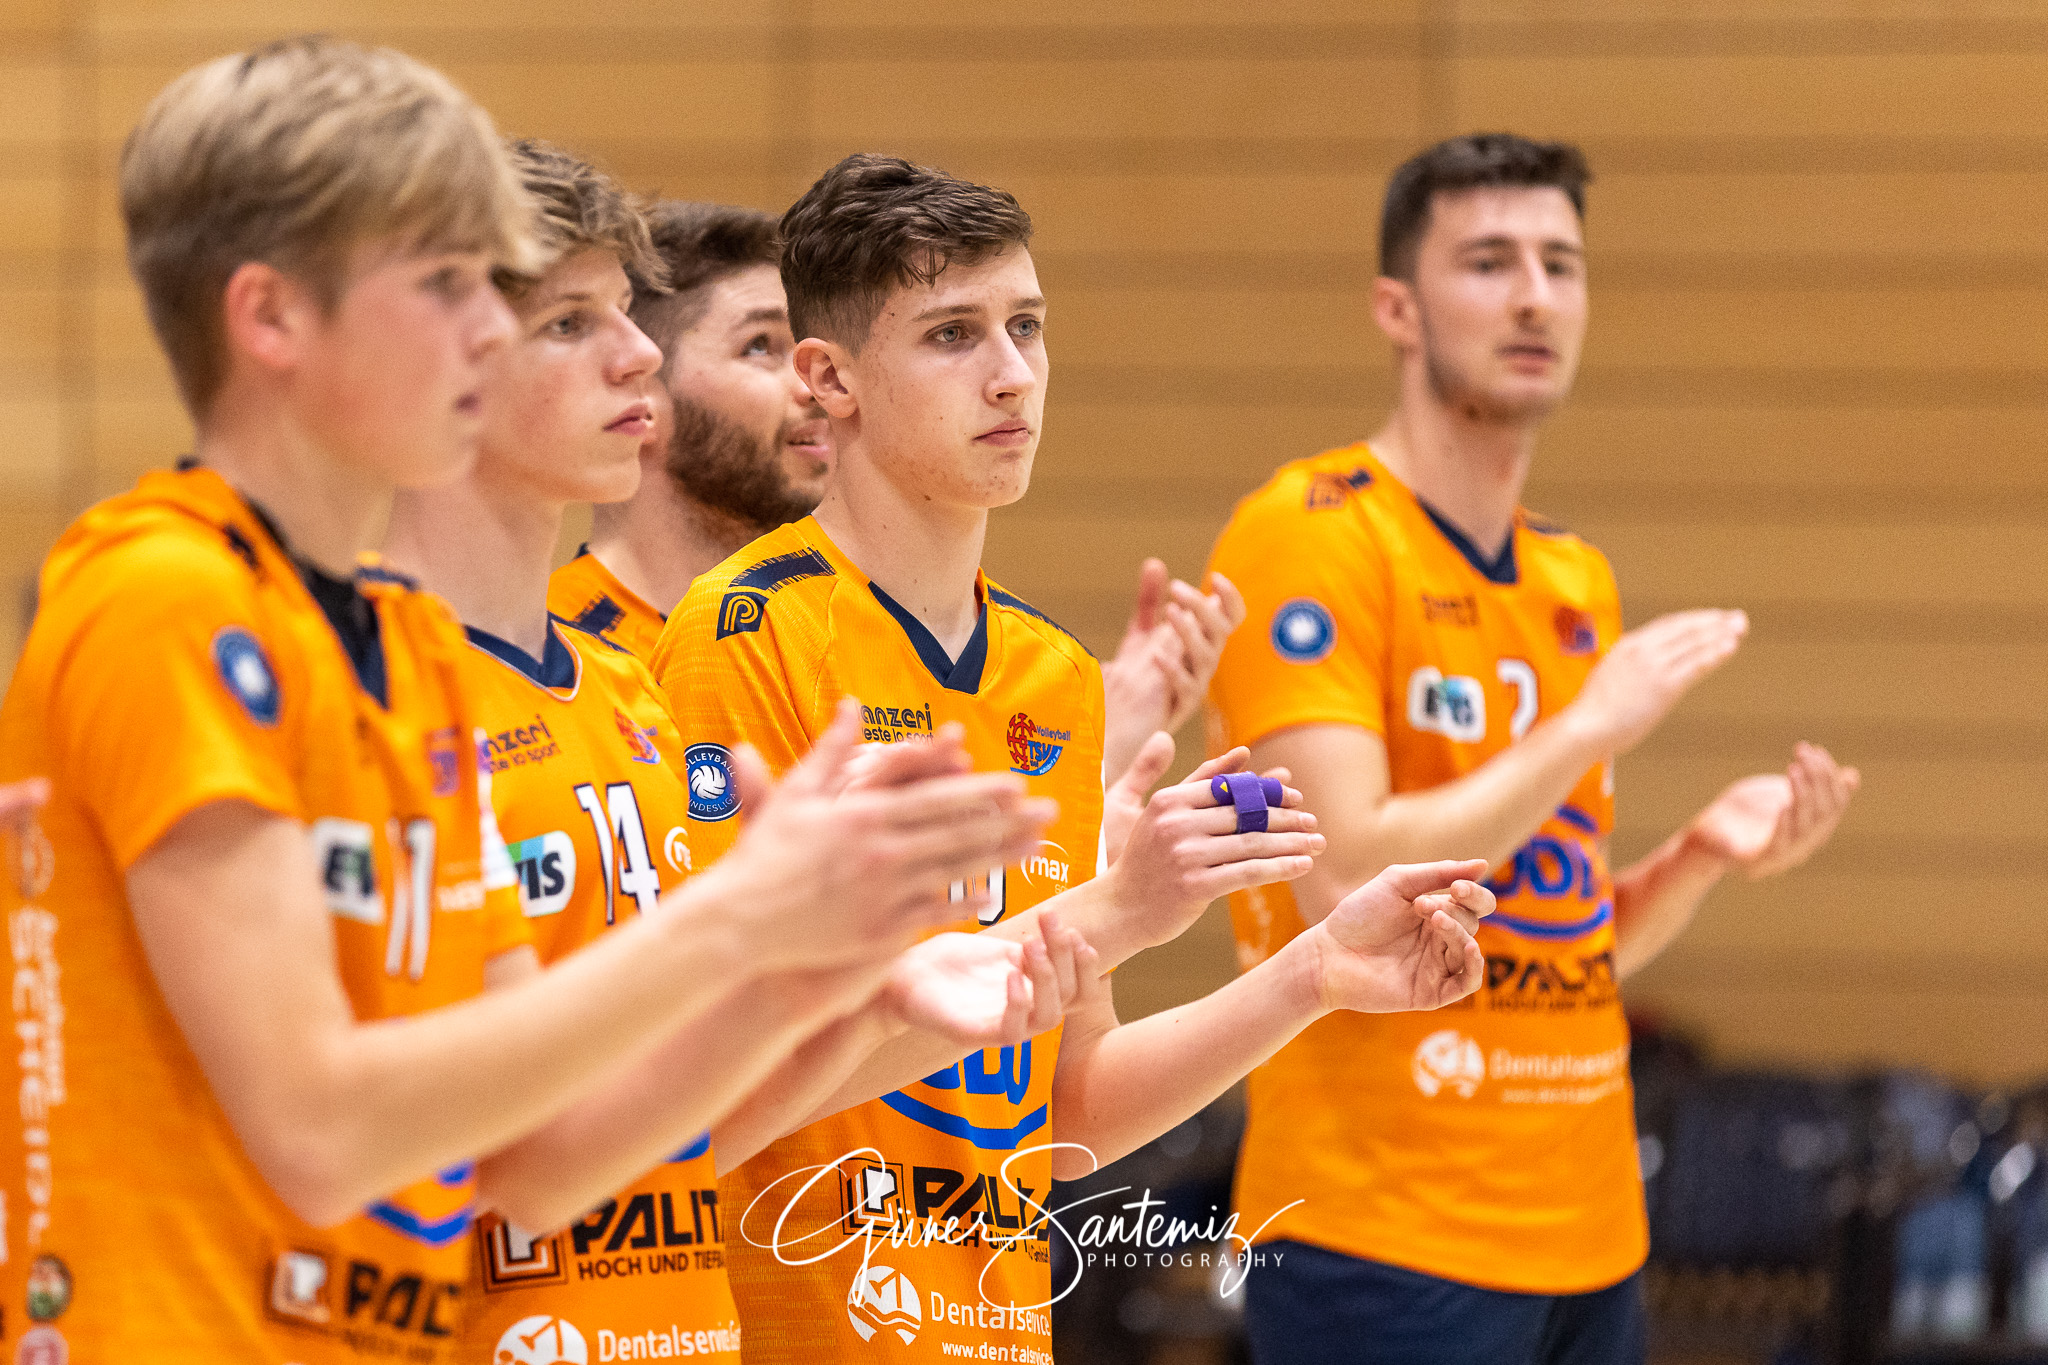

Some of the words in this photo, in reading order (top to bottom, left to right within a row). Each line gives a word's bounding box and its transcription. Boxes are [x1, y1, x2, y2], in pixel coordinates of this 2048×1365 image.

[1027, 740, 1052, 762] TSV
[685, 753, 737, 778] OLLEYBALL
[688, 793, 737, 813] NDESLIGA
[573, 782, 661, 925] 14
[1029, 855, 1070, 883] max
[578, 1256, 642, 1281] HOCH
[648, 1252, 689, 1275] UND
